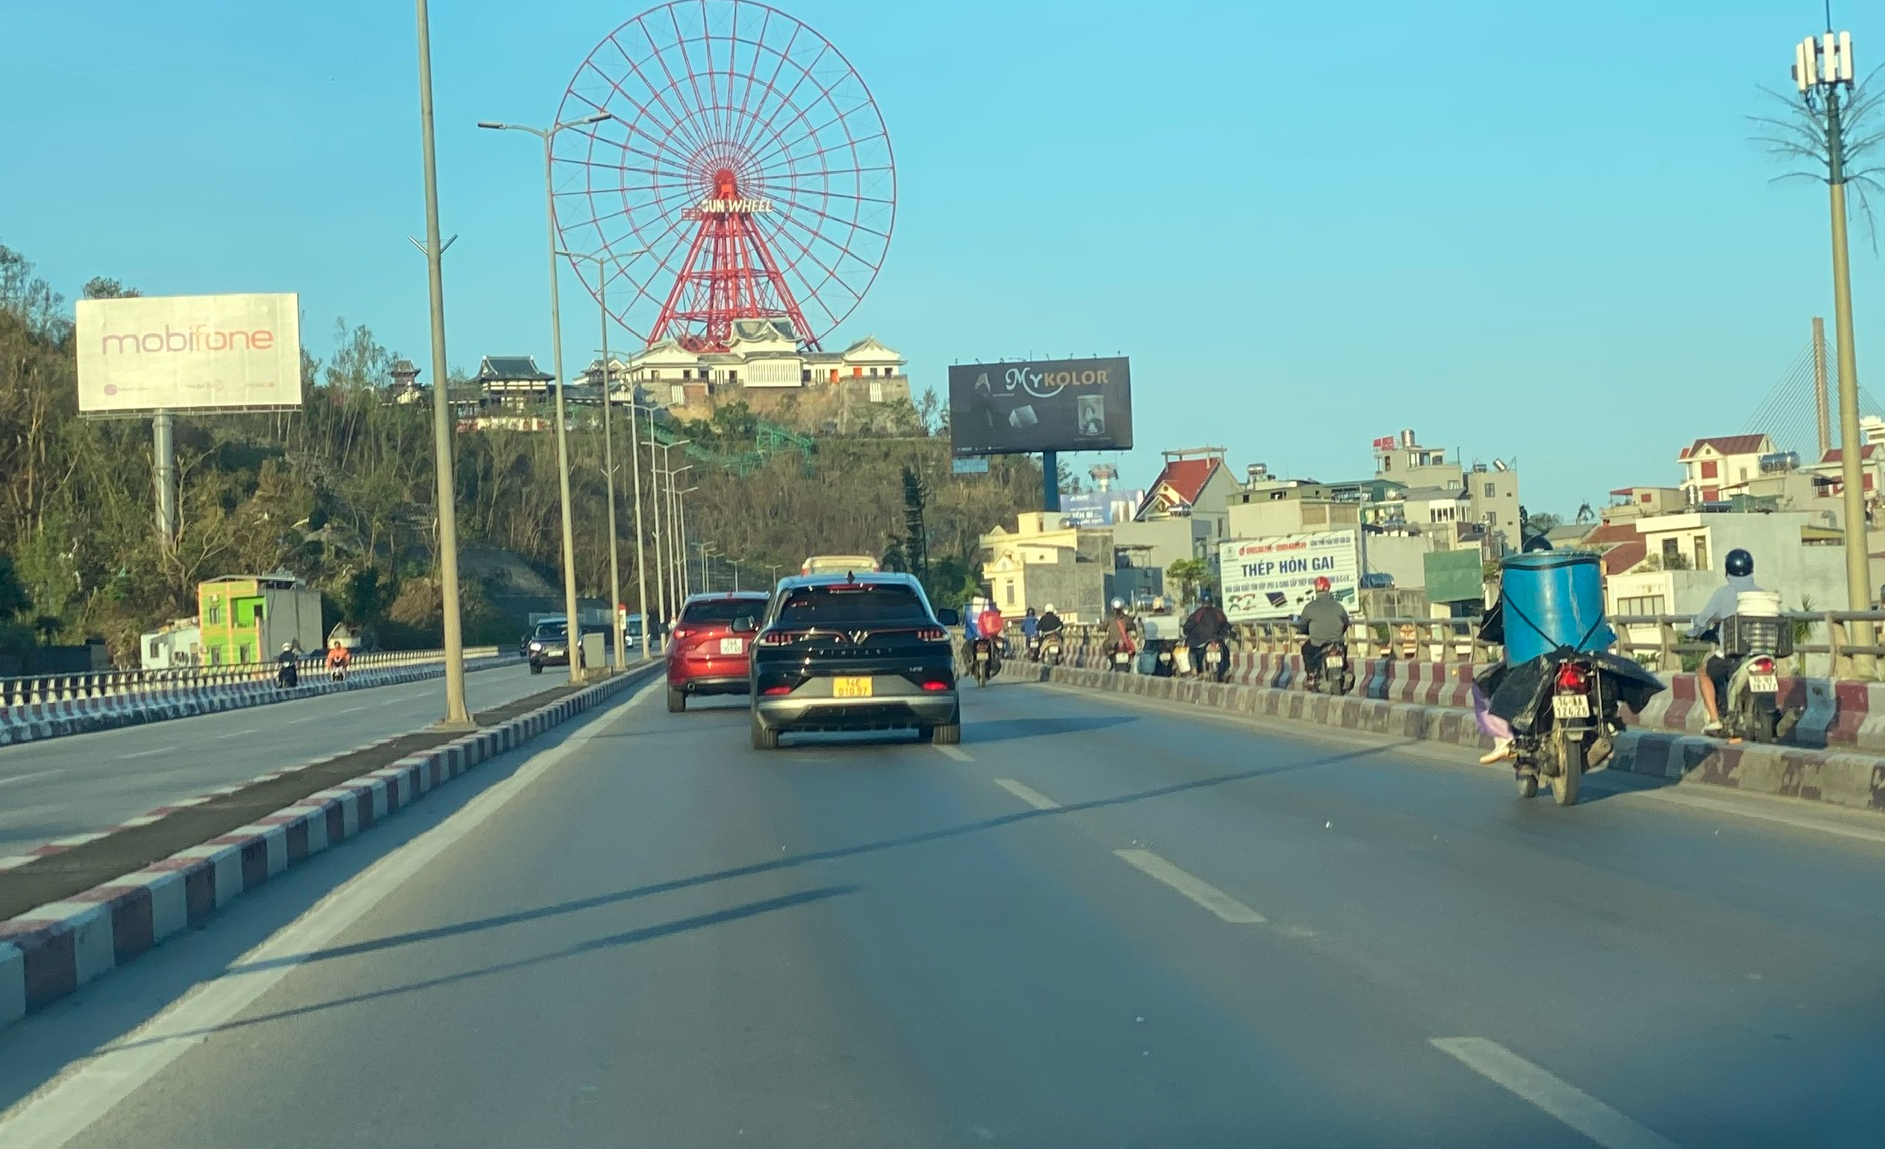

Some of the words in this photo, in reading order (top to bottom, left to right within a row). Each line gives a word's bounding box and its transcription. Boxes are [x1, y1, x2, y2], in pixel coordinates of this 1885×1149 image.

[701, 199, 725, 213] SUN
[728, 199, 773, 213] WHEEL
[102, 324, 274, 355] mobifone
[1241, 559, 1274, 577] THÉP
[1312, 556, 1334, 571] GAI
